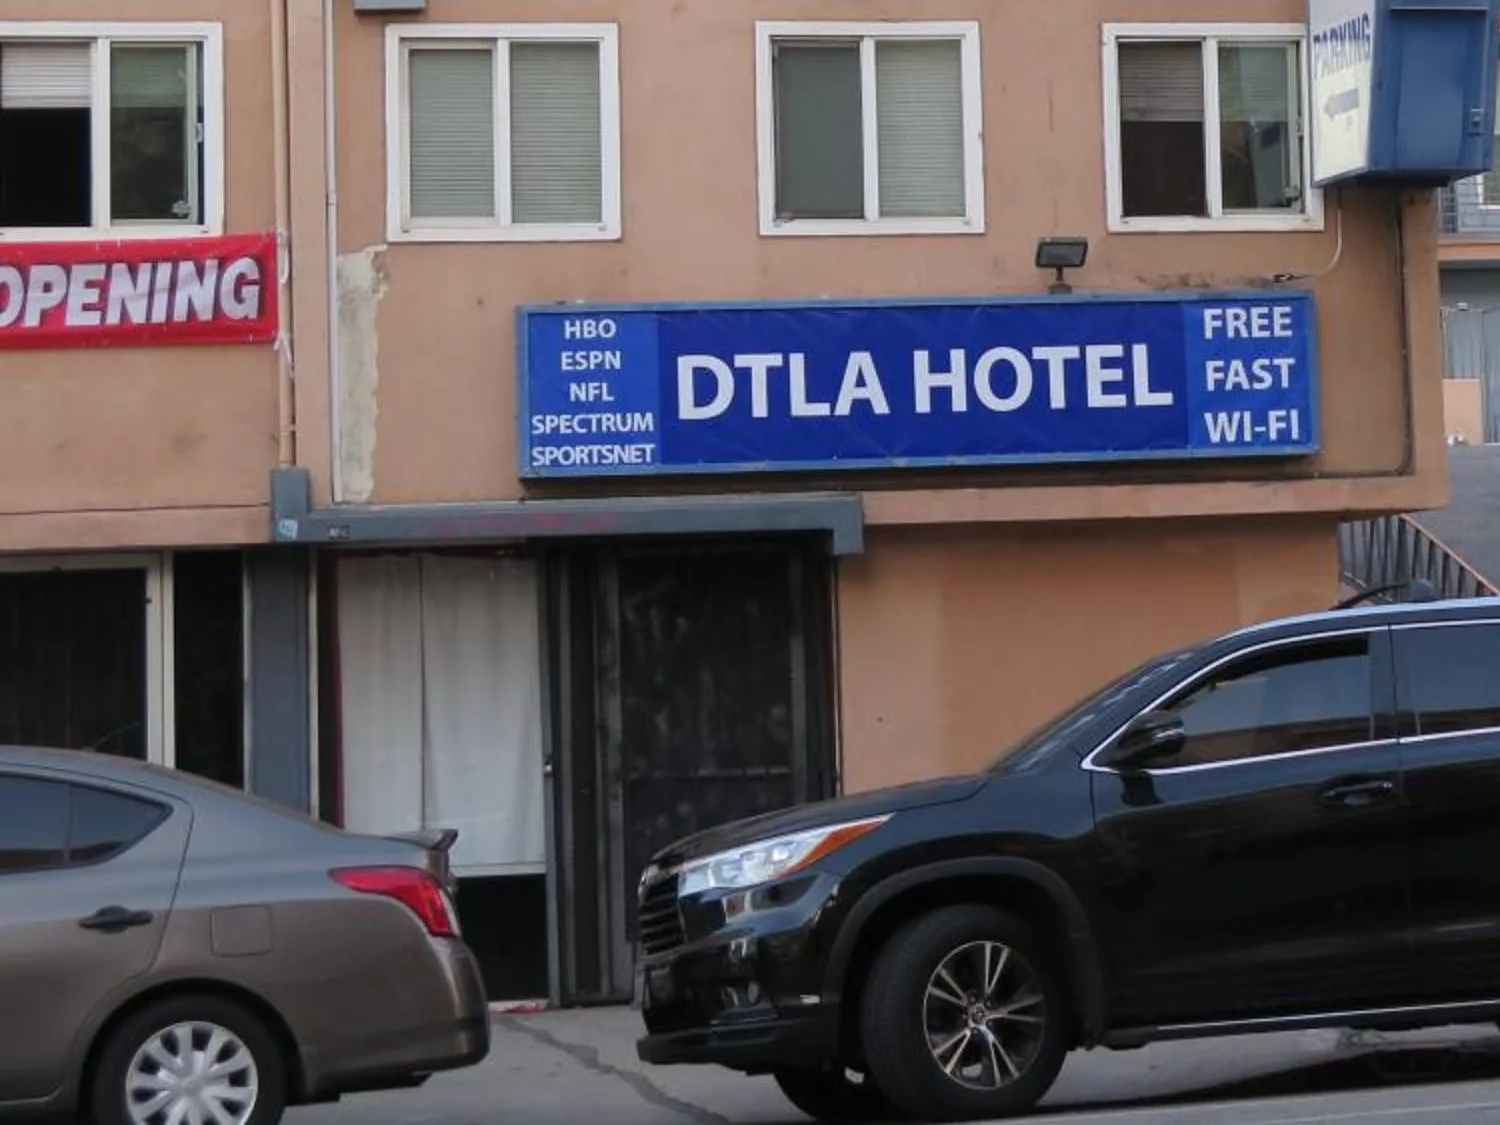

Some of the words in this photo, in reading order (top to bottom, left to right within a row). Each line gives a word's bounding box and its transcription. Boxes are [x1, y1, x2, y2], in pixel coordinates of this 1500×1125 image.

[1313, 13, 1371, 81] PARKING
[0, 257, 261, 327] OPENING
[563, 318, 617, 340] HBO
[1203, 305, 1294, 340] FREE
[561, 350, 622, 372] ESPN
[1205, 357, 1297, 392] FAST
[568, 381, 615, 402] NFL
[676, 350, 891, 421] DTLA
[912, 343, 1175, 414] HOTEL
[531, 412, 654, 435] SPECTRUM
[1203, 408, 1300, 444] WI-FI
[531, 443, 656, 467] SPORTSNET
